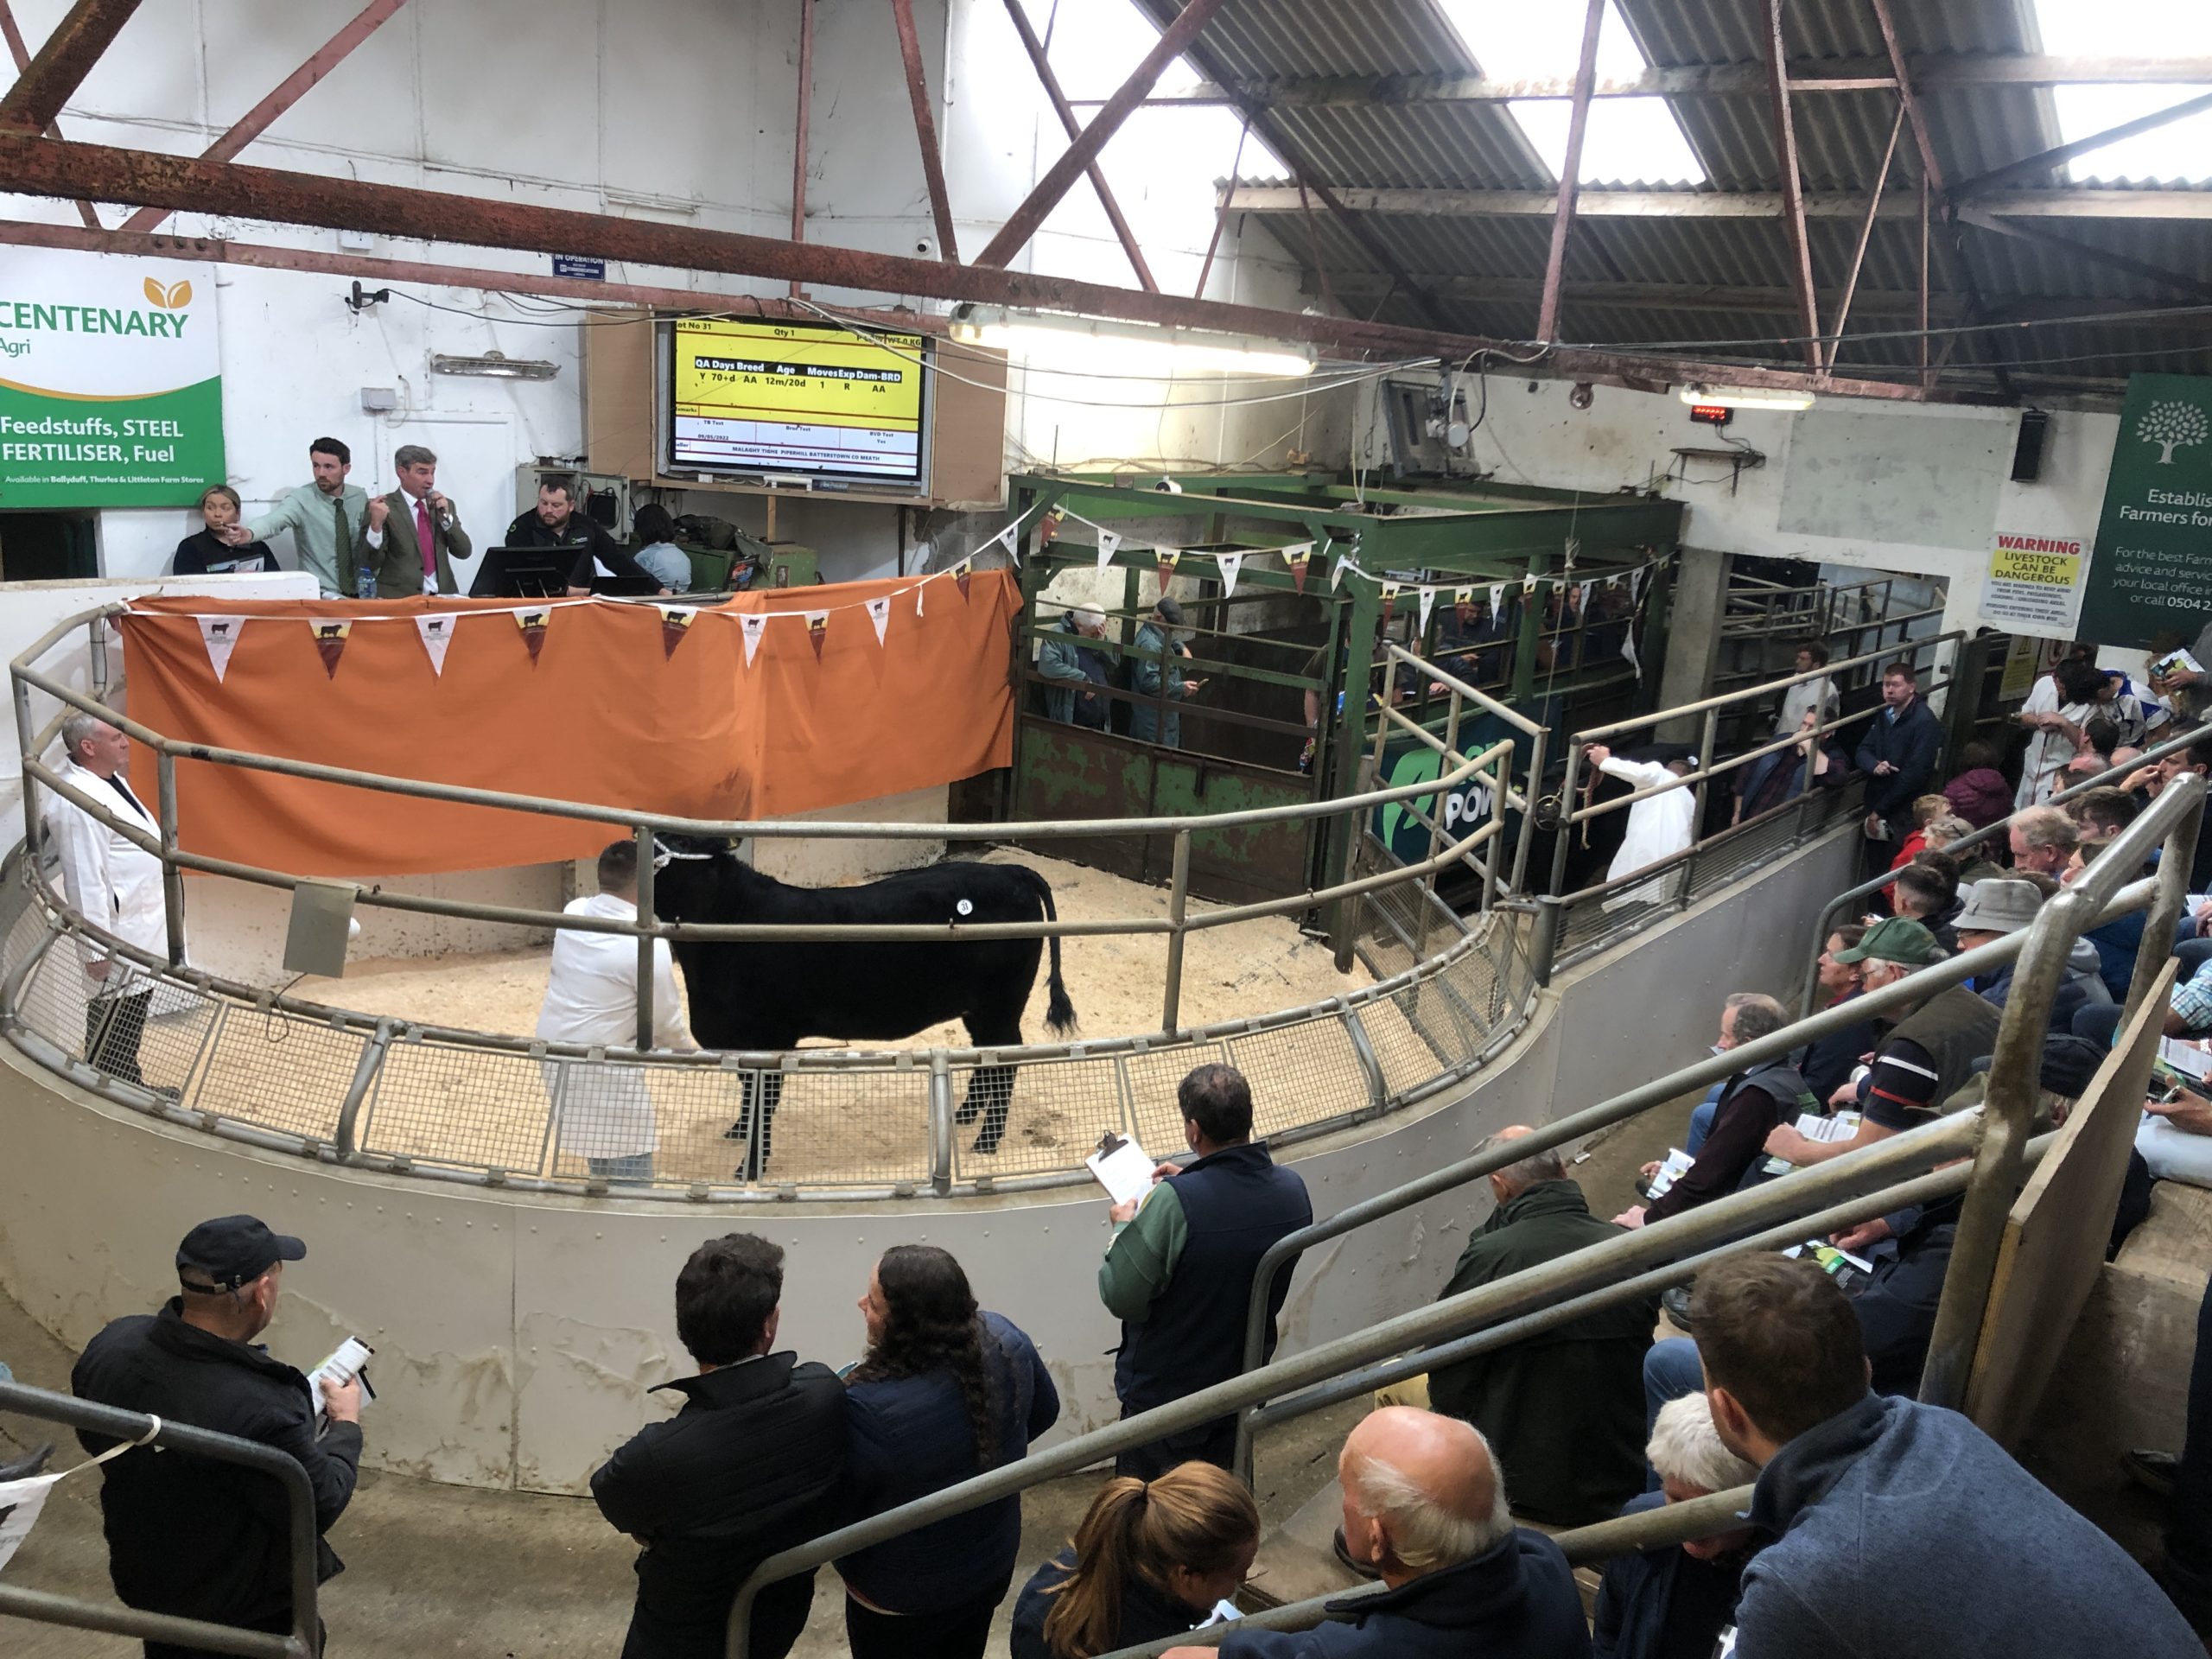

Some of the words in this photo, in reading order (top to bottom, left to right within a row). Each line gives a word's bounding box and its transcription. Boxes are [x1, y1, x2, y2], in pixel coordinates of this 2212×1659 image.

[0, 302, 188, 338] CENTENARY
[774, 328, 789, 337] Qty
[0, 338, 30, 358] Agri
[696, 359, 710, 369] QA
[712, 360, 734, 372] Days
[737, 362, 764, 372] Breed
[776, 365, 795, 375] Age
[807, 367, 837, 378] Moves
[838, 369, 855, 380] Exp
[856, 371, 901, 381] Dam-BRD
[711, 373, 735, 382] 70+d
[743, 375, 757, 384] AA
[766, 377, 805, 387] 12m/20d
[0, 416, 118, 438] Feedstuffs,
[123, 419, 184, 437] STEEL
[2, 443, 129, 464] FERTILISER,
[134, 445, 174, 461] Fuel
[2120, 505, 2188, 524] Farmers
[1999, 535, 2081, 555] WARNING
[2005, 552, 2068, 566] LIVESTOCK
[2115, 546, 2135, 557] For
[2137, 550, 2156, 560] the
[2158, 550, 2183, 563] best
[1995, 569, 2071, 585] DANGEROUS
[2012, 563, 2038, 572] CAN
[2043, 565, 2056, 574] BE
[2115, 563, 2152, 574] advice
[2153, 567, 2177, 577] and
[2112, 579, 2139, 588] your
[2140, 578, 2168, 591] local
[2171, 582, 2202, 595] office
[2130, 594, 2144, 603] or
[2145, 595, 2165, 606] call
[2167, 596, 2201, 609] 0504
